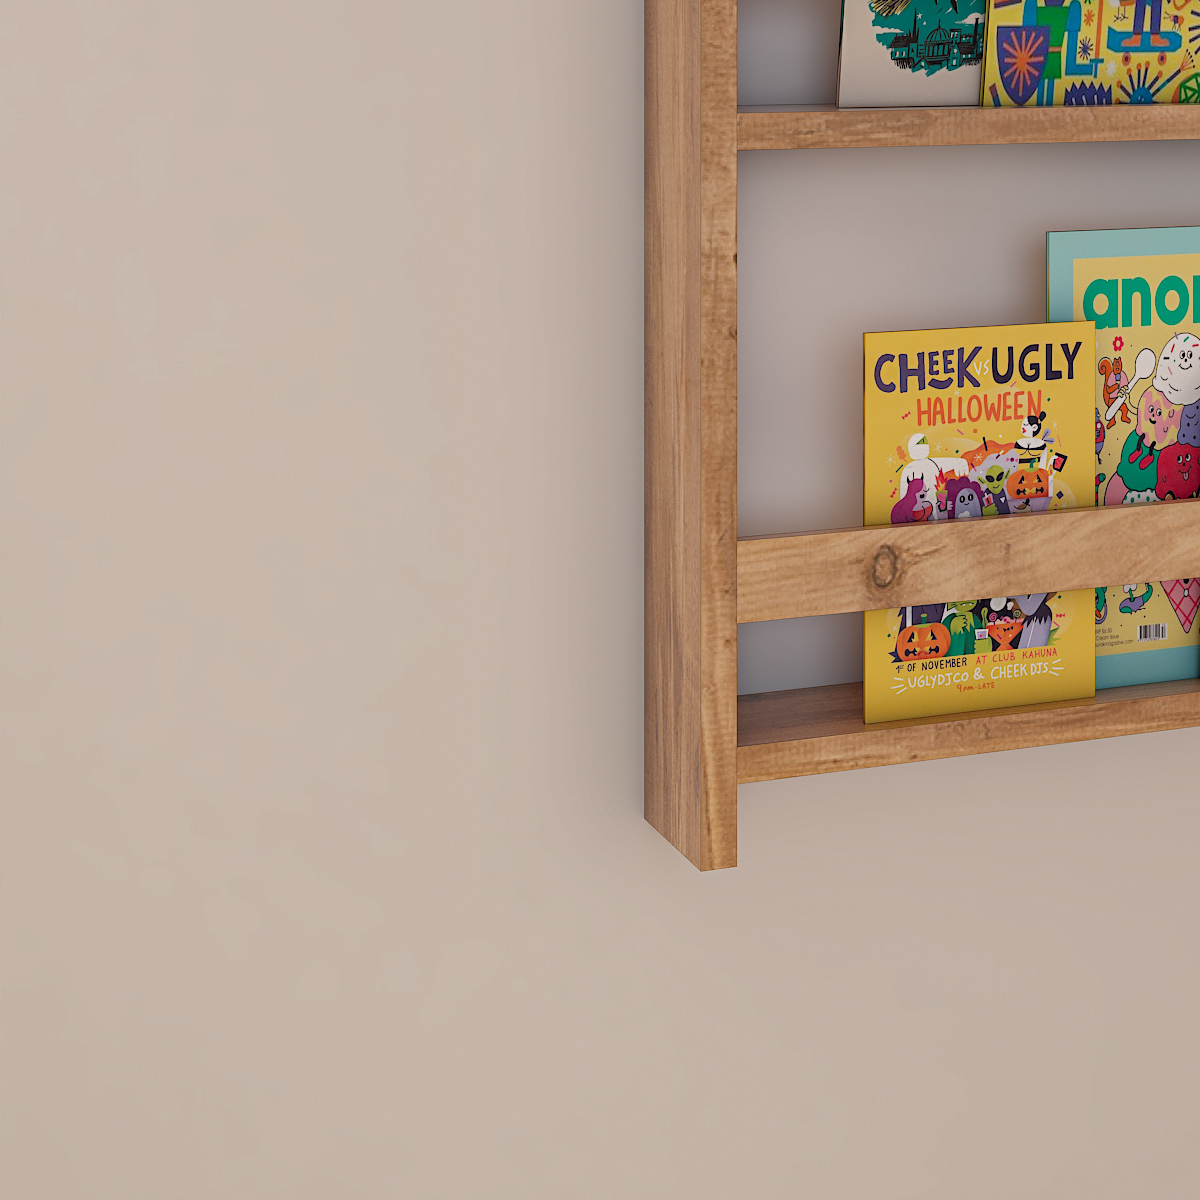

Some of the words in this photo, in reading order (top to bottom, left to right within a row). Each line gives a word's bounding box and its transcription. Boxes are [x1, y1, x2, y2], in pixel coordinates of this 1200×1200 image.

[874, 346, 982, 393] CHEEK
[992, 341, 1082, 384] UGLY
[917, 390, 1042, 426] HALLOWEEN
[907, 663, 917, 672] OF
[921, 657, 967, 671] NOVEMBER
[976, 655, 987, 665] AT
[992, 651, 1016, 663] CLUB
[1022, 647, 1057, 660] KAHUNA
[973, 667, 984, 680] &
[990, 664, 1028, 678] CHEEK
[1030, 662, 1049, 674] DJS
